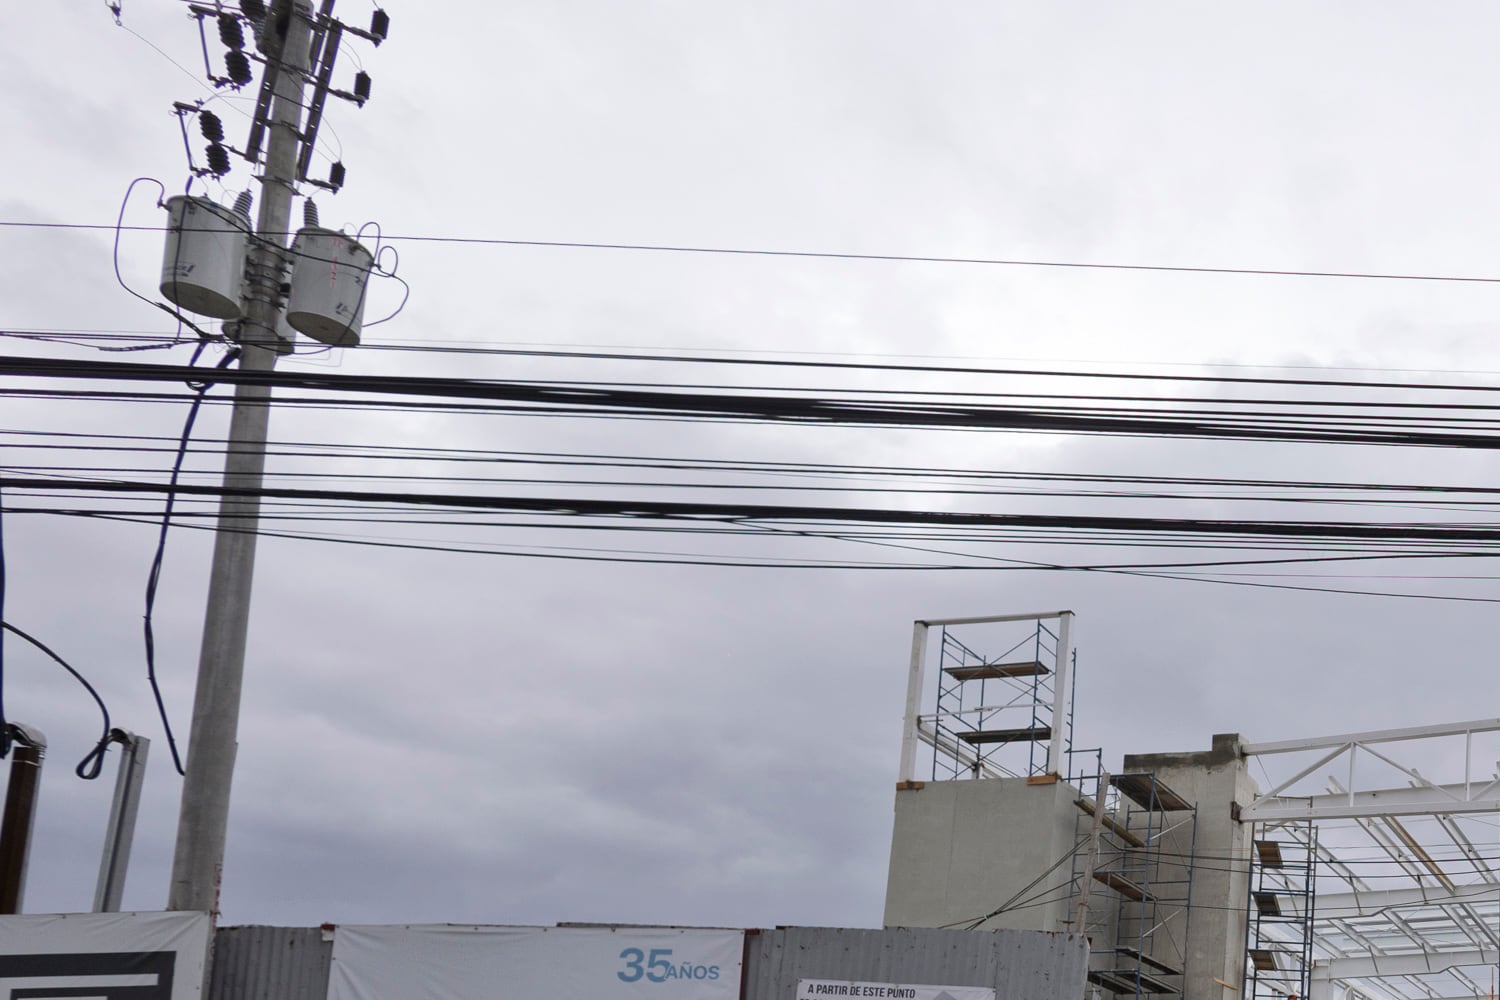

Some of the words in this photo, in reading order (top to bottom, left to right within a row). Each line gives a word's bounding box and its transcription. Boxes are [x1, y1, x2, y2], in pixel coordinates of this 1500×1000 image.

[617, 947, 673, 983] 35
[665, 961, 720, 980] AÑOS
[808, 984, 814, 994] A
[816, 984, 847, 995] PARTIR
[850, 986, 861, 996] DE
[863, 986, 884, 997] ESTE
[887, 988, 915, 998] PUNTO
